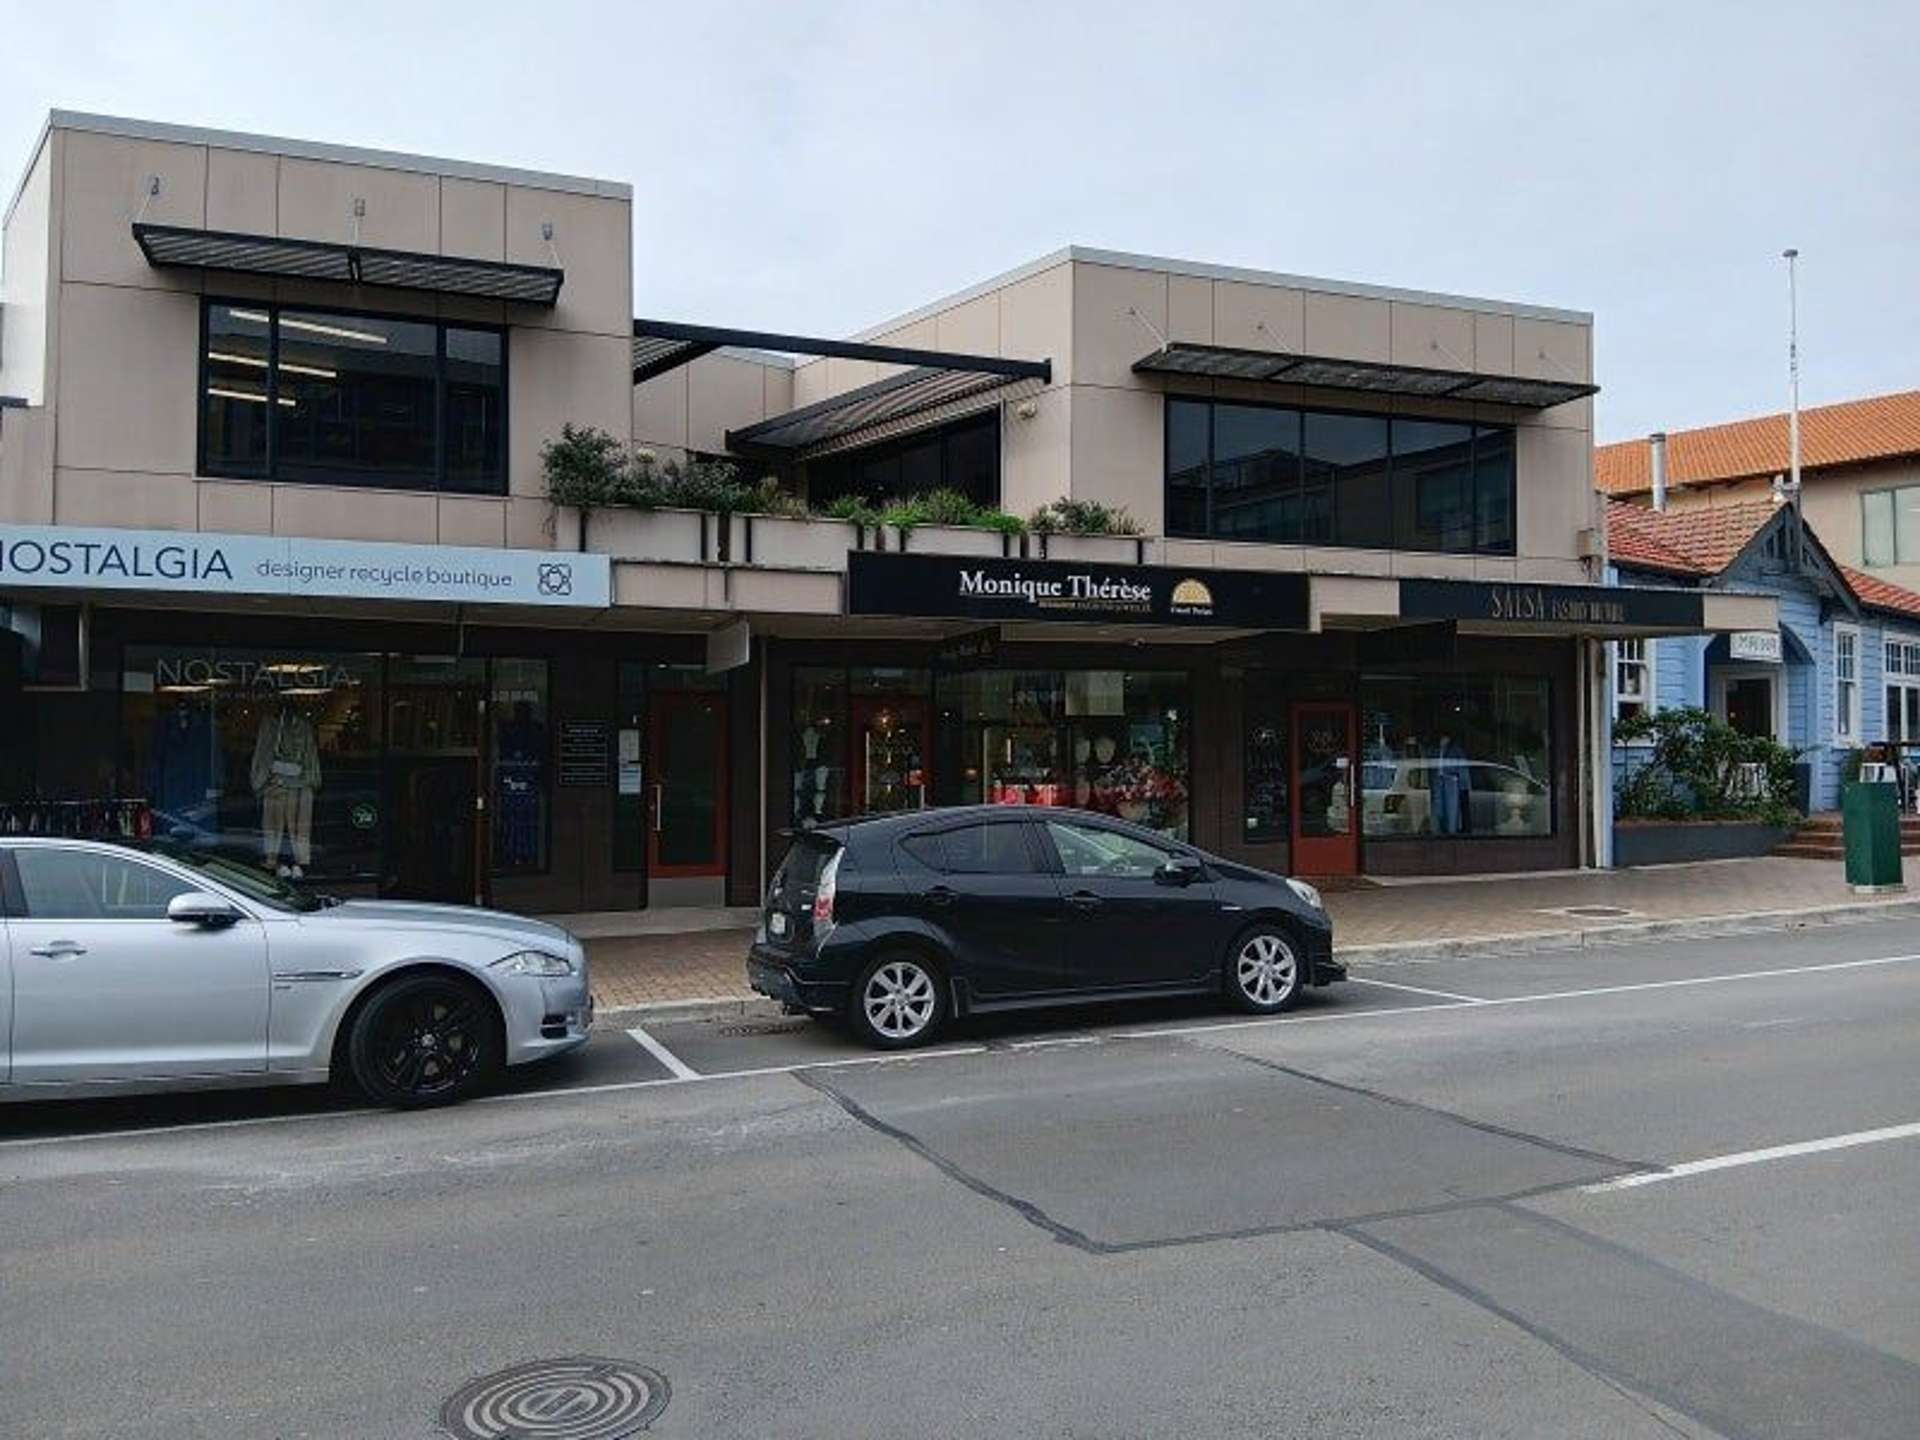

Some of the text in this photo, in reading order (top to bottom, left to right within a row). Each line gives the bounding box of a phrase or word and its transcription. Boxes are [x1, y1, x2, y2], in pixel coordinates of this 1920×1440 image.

[256, 558, 513, 590] designer recycle boutique
[958, 570, 1152, 604] Monique Thérèse
[1491, 587, 1545, 621] SALSA
[157, 658, 350, 689] NOSTALGIA
